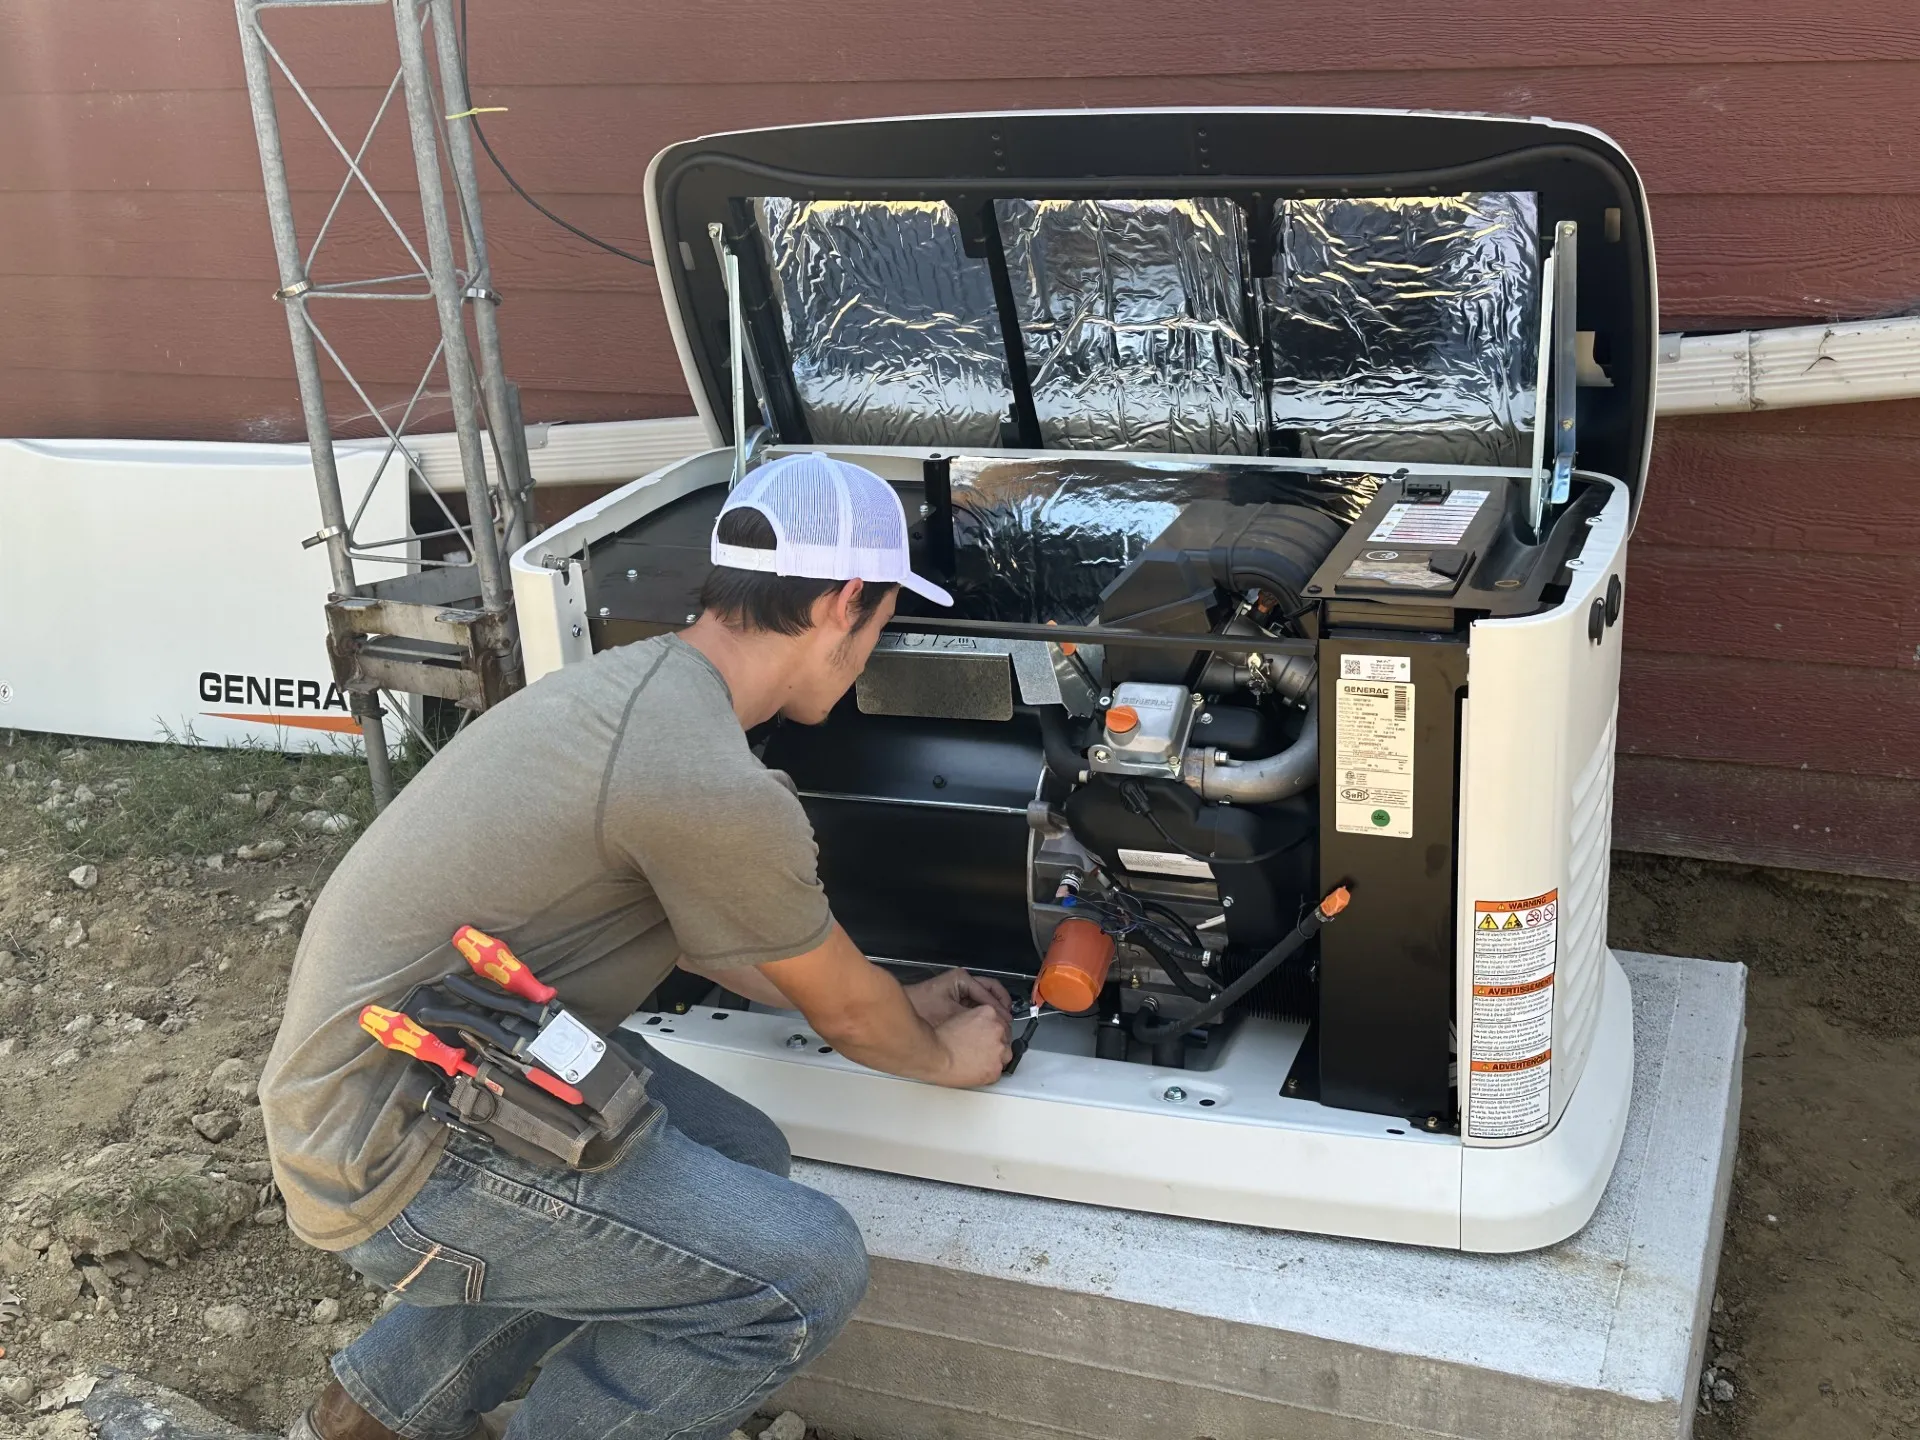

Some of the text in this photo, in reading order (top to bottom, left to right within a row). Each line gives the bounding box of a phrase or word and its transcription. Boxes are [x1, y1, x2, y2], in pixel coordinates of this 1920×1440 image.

[199, 671, 349, 712] GENERA
[1344, 685, 1389, 695] GENERAC
[1508, 896, 1547, 910] WARNING
[1488, 976, 1552, 996] AVERTISSEMENT
[1492, 1054, 1547, 1071] ADVERTENCIA
